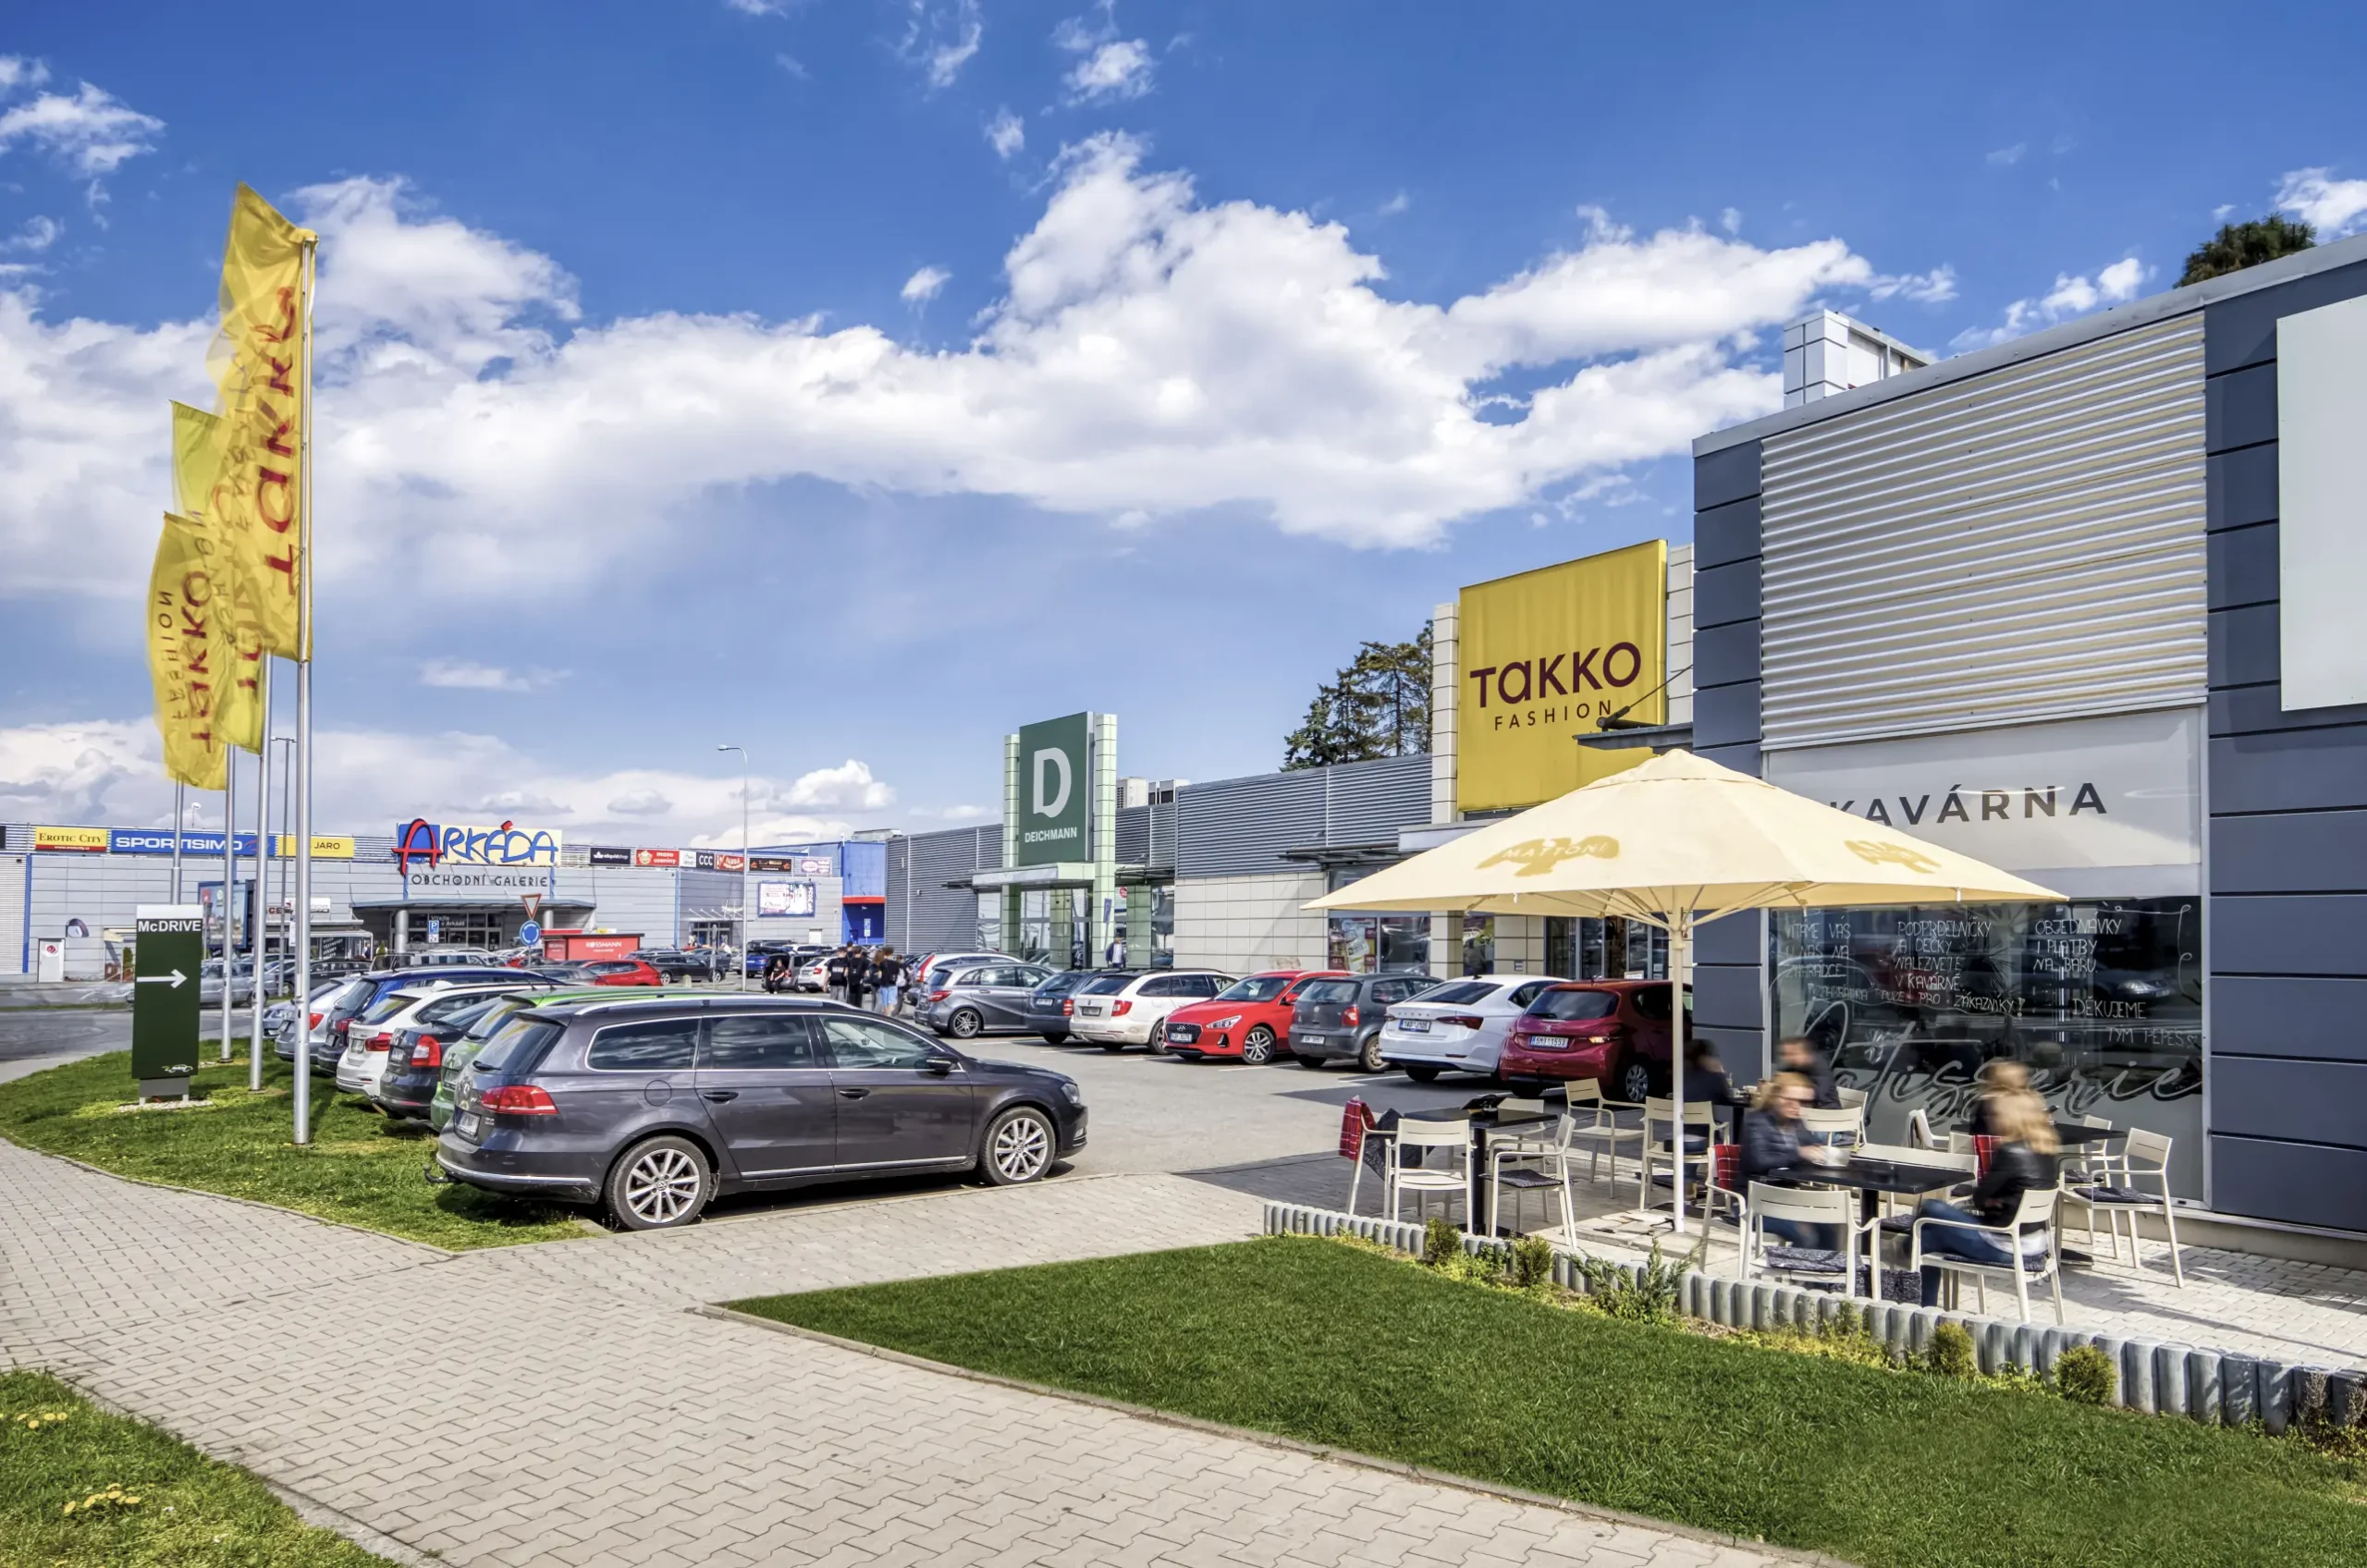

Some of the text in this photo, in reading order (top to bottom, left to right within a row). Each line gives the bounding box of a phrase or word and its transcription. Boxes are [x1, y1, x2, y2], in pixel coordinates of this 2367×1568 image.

[1494, 700, 1612, 730] FASHION
[1033, 747, 1072, 818] D
[1024, 827, 1077, 842] DEICHMANN
[313, 841, 340, 850] JARO
[1502, 841, 1610, 858] MATTONI
[698, 855, 713, 866] CCC
[411, 874, 548, 888] OBCHODNÍ GALERIE
[138, 920, 202, 933] McDRIVE
[1828, 915, 1851, 939] VÁS
[2035, 911, 2122, 936] OBJEDNÁVKY
[1831, 945, 1849, 959] NA
[2047, 939, 2098, 954] PLATBY
[1895, 956, 1966, 972] NALEZNETE
[2033, 958, 2054, 971] NA
[1918, 990, 1941, 1005] PRO
[2072, 996, 2147, 1020] DĚKUJEME
